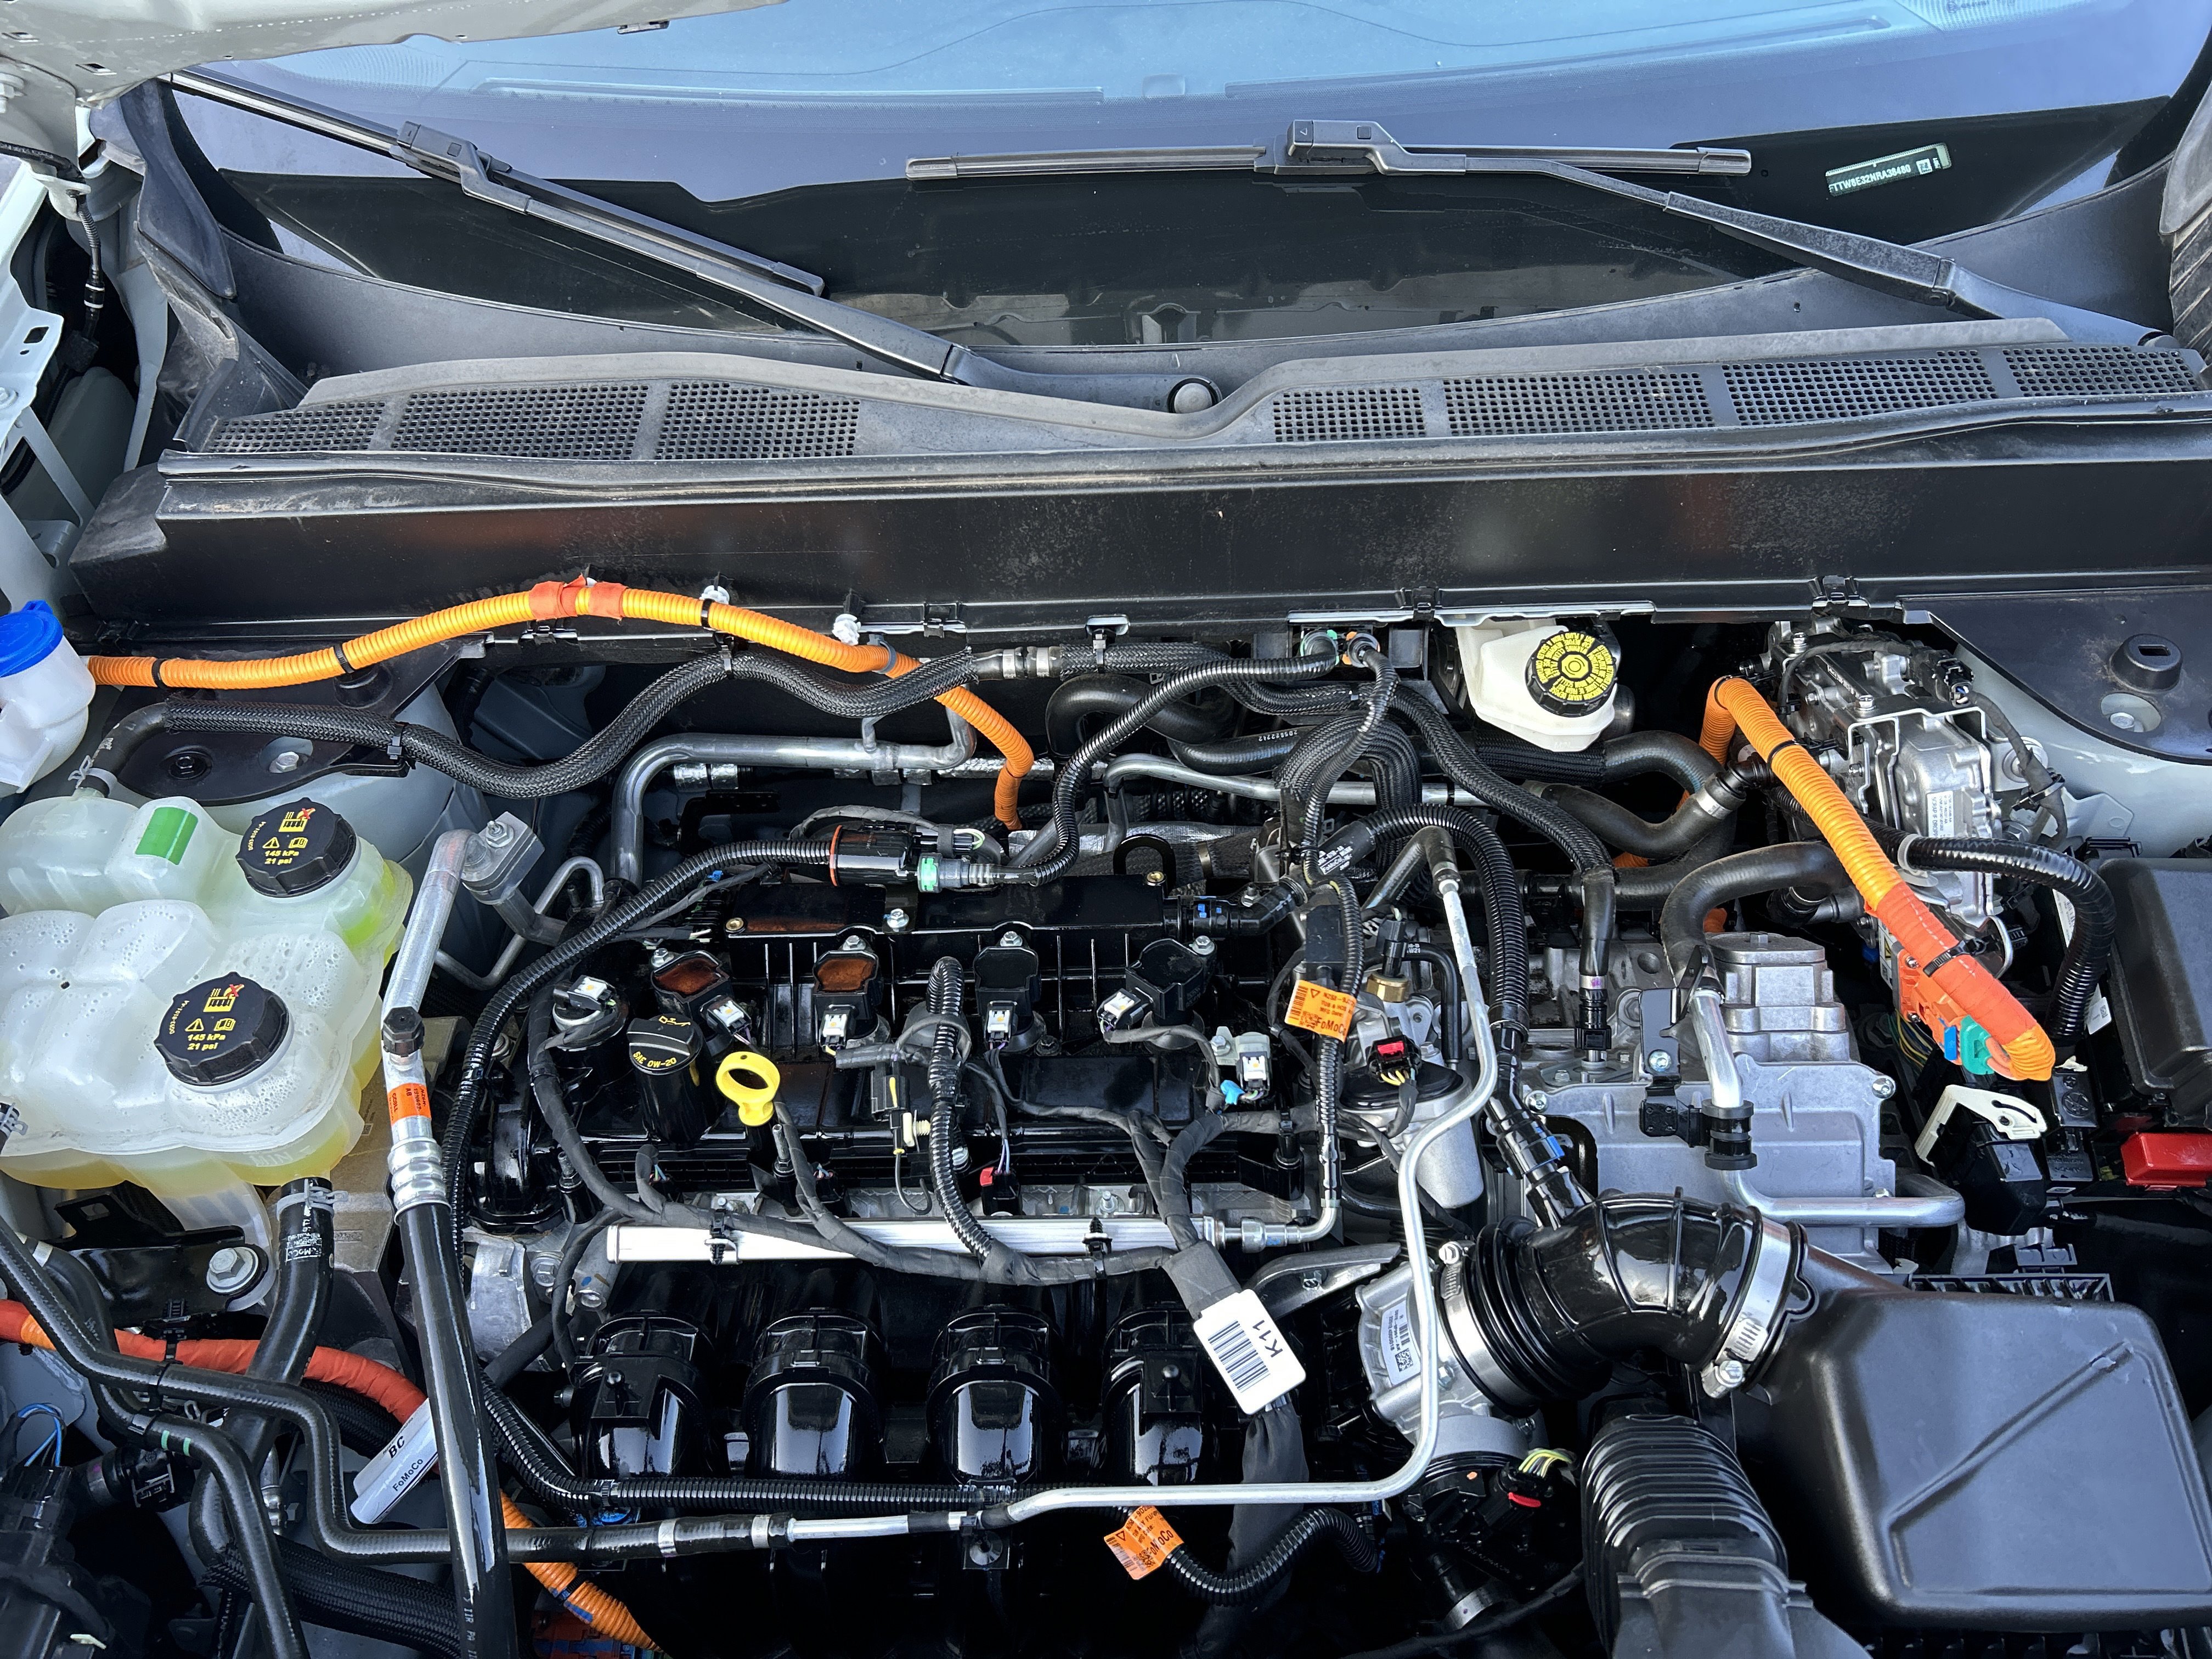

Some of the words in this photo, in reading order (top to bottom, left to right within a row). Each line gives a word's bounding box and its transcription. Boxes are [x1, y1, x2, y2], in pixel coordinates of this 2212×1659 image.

[1317, 1017, 1346, 1036] FoMoCo
[201, 1042, 219, 1051] psi
[633, 1051, 647, 1064] SAE
[1252, 1320, 1283, 1358] K11
[388, 1436, 405, 1458] BC
[392, 1459, 424, 1491] FoMoCo
[1147, 1530, 1174, 1556] FoMoCo
